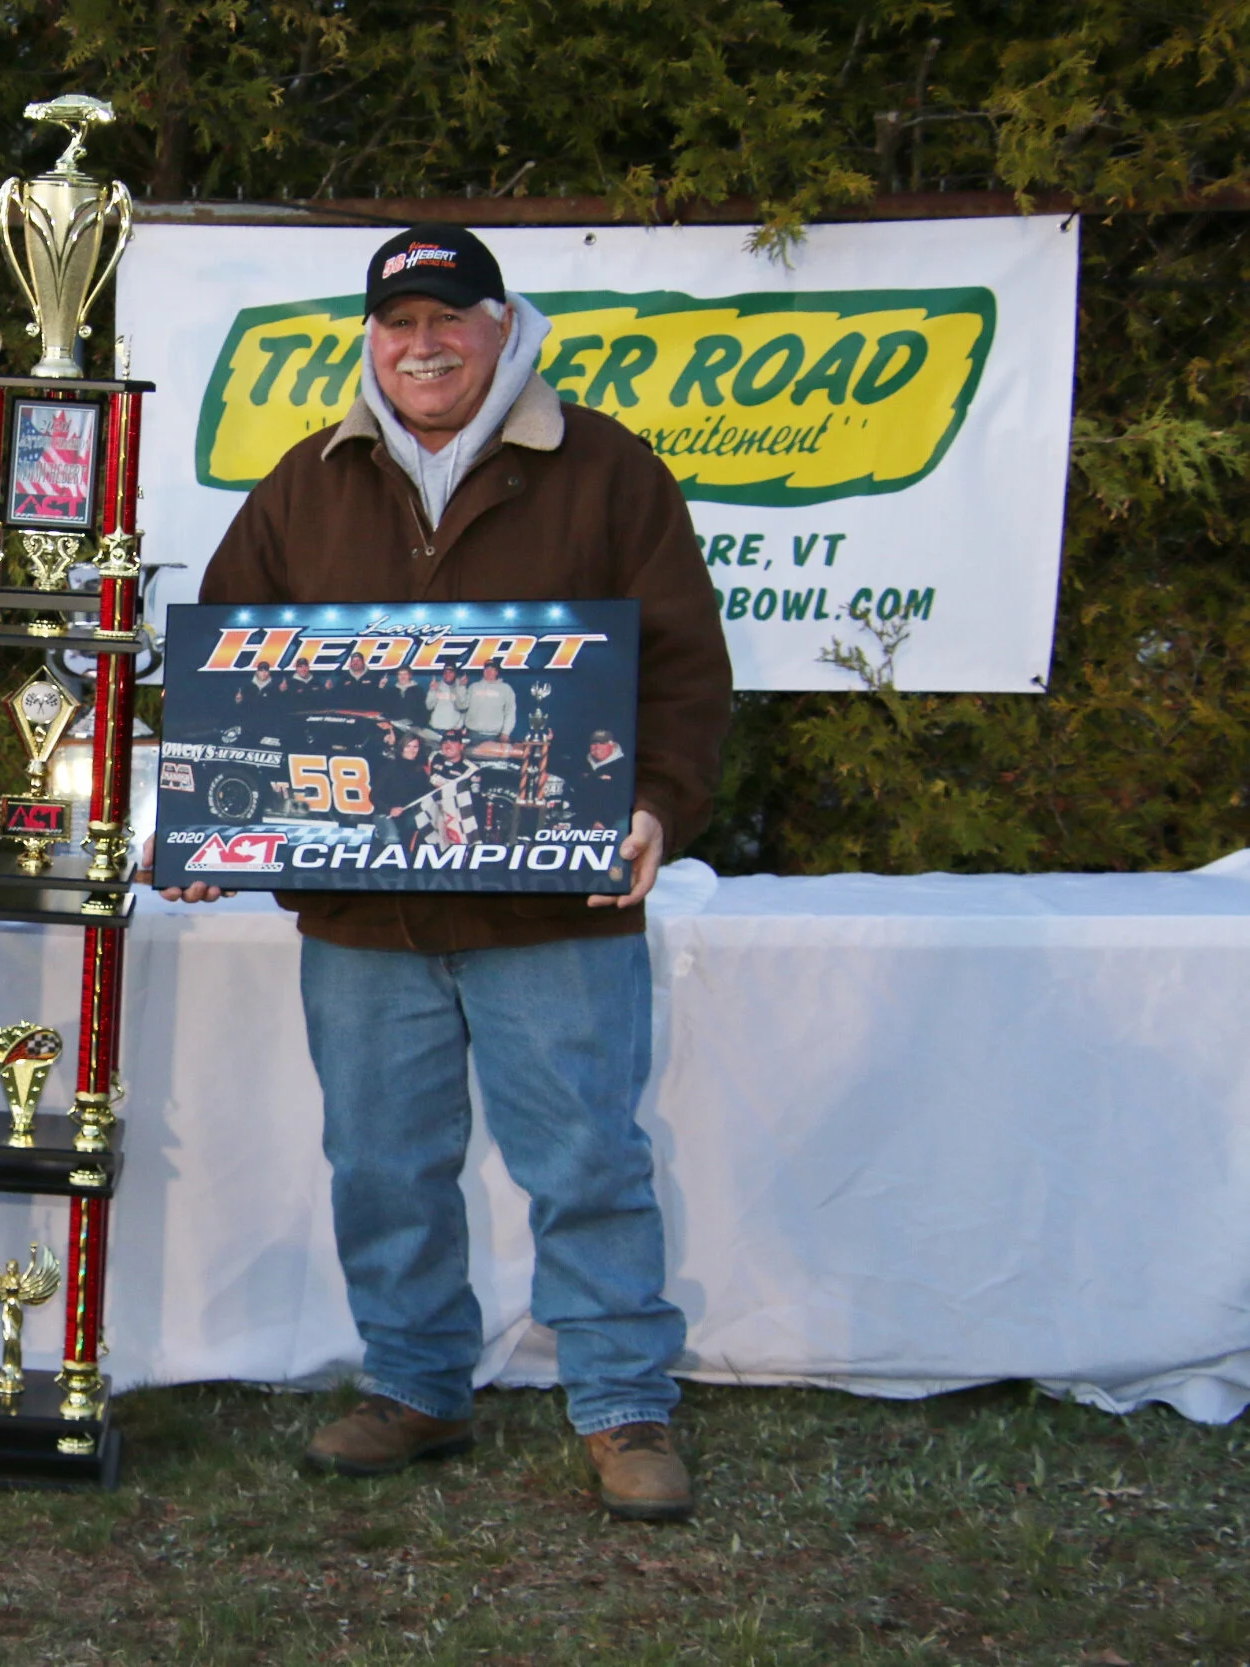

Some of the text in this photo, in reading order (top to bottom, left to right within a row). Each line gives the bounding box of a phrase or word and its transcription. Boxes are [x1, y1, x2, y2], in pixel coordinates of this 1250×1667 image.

[406, 249, 457, 269] HEBERT
[670, 329, 929, 406] ROAD
[14, 495, 84, 517] ACT
[792, 533, 846, 567] VT
[358, 615, 453, 644] Larry
[198, 627, 608, 672] HEBERT
[245, 752, 283, 766] SALES
[288, 753, 374, 816] 58
[8, 805, 63, 829] ACT
[534, 829, 618, 842] OWNER
[167, 831, 615, 871] 2020 ACT CHAMPION
